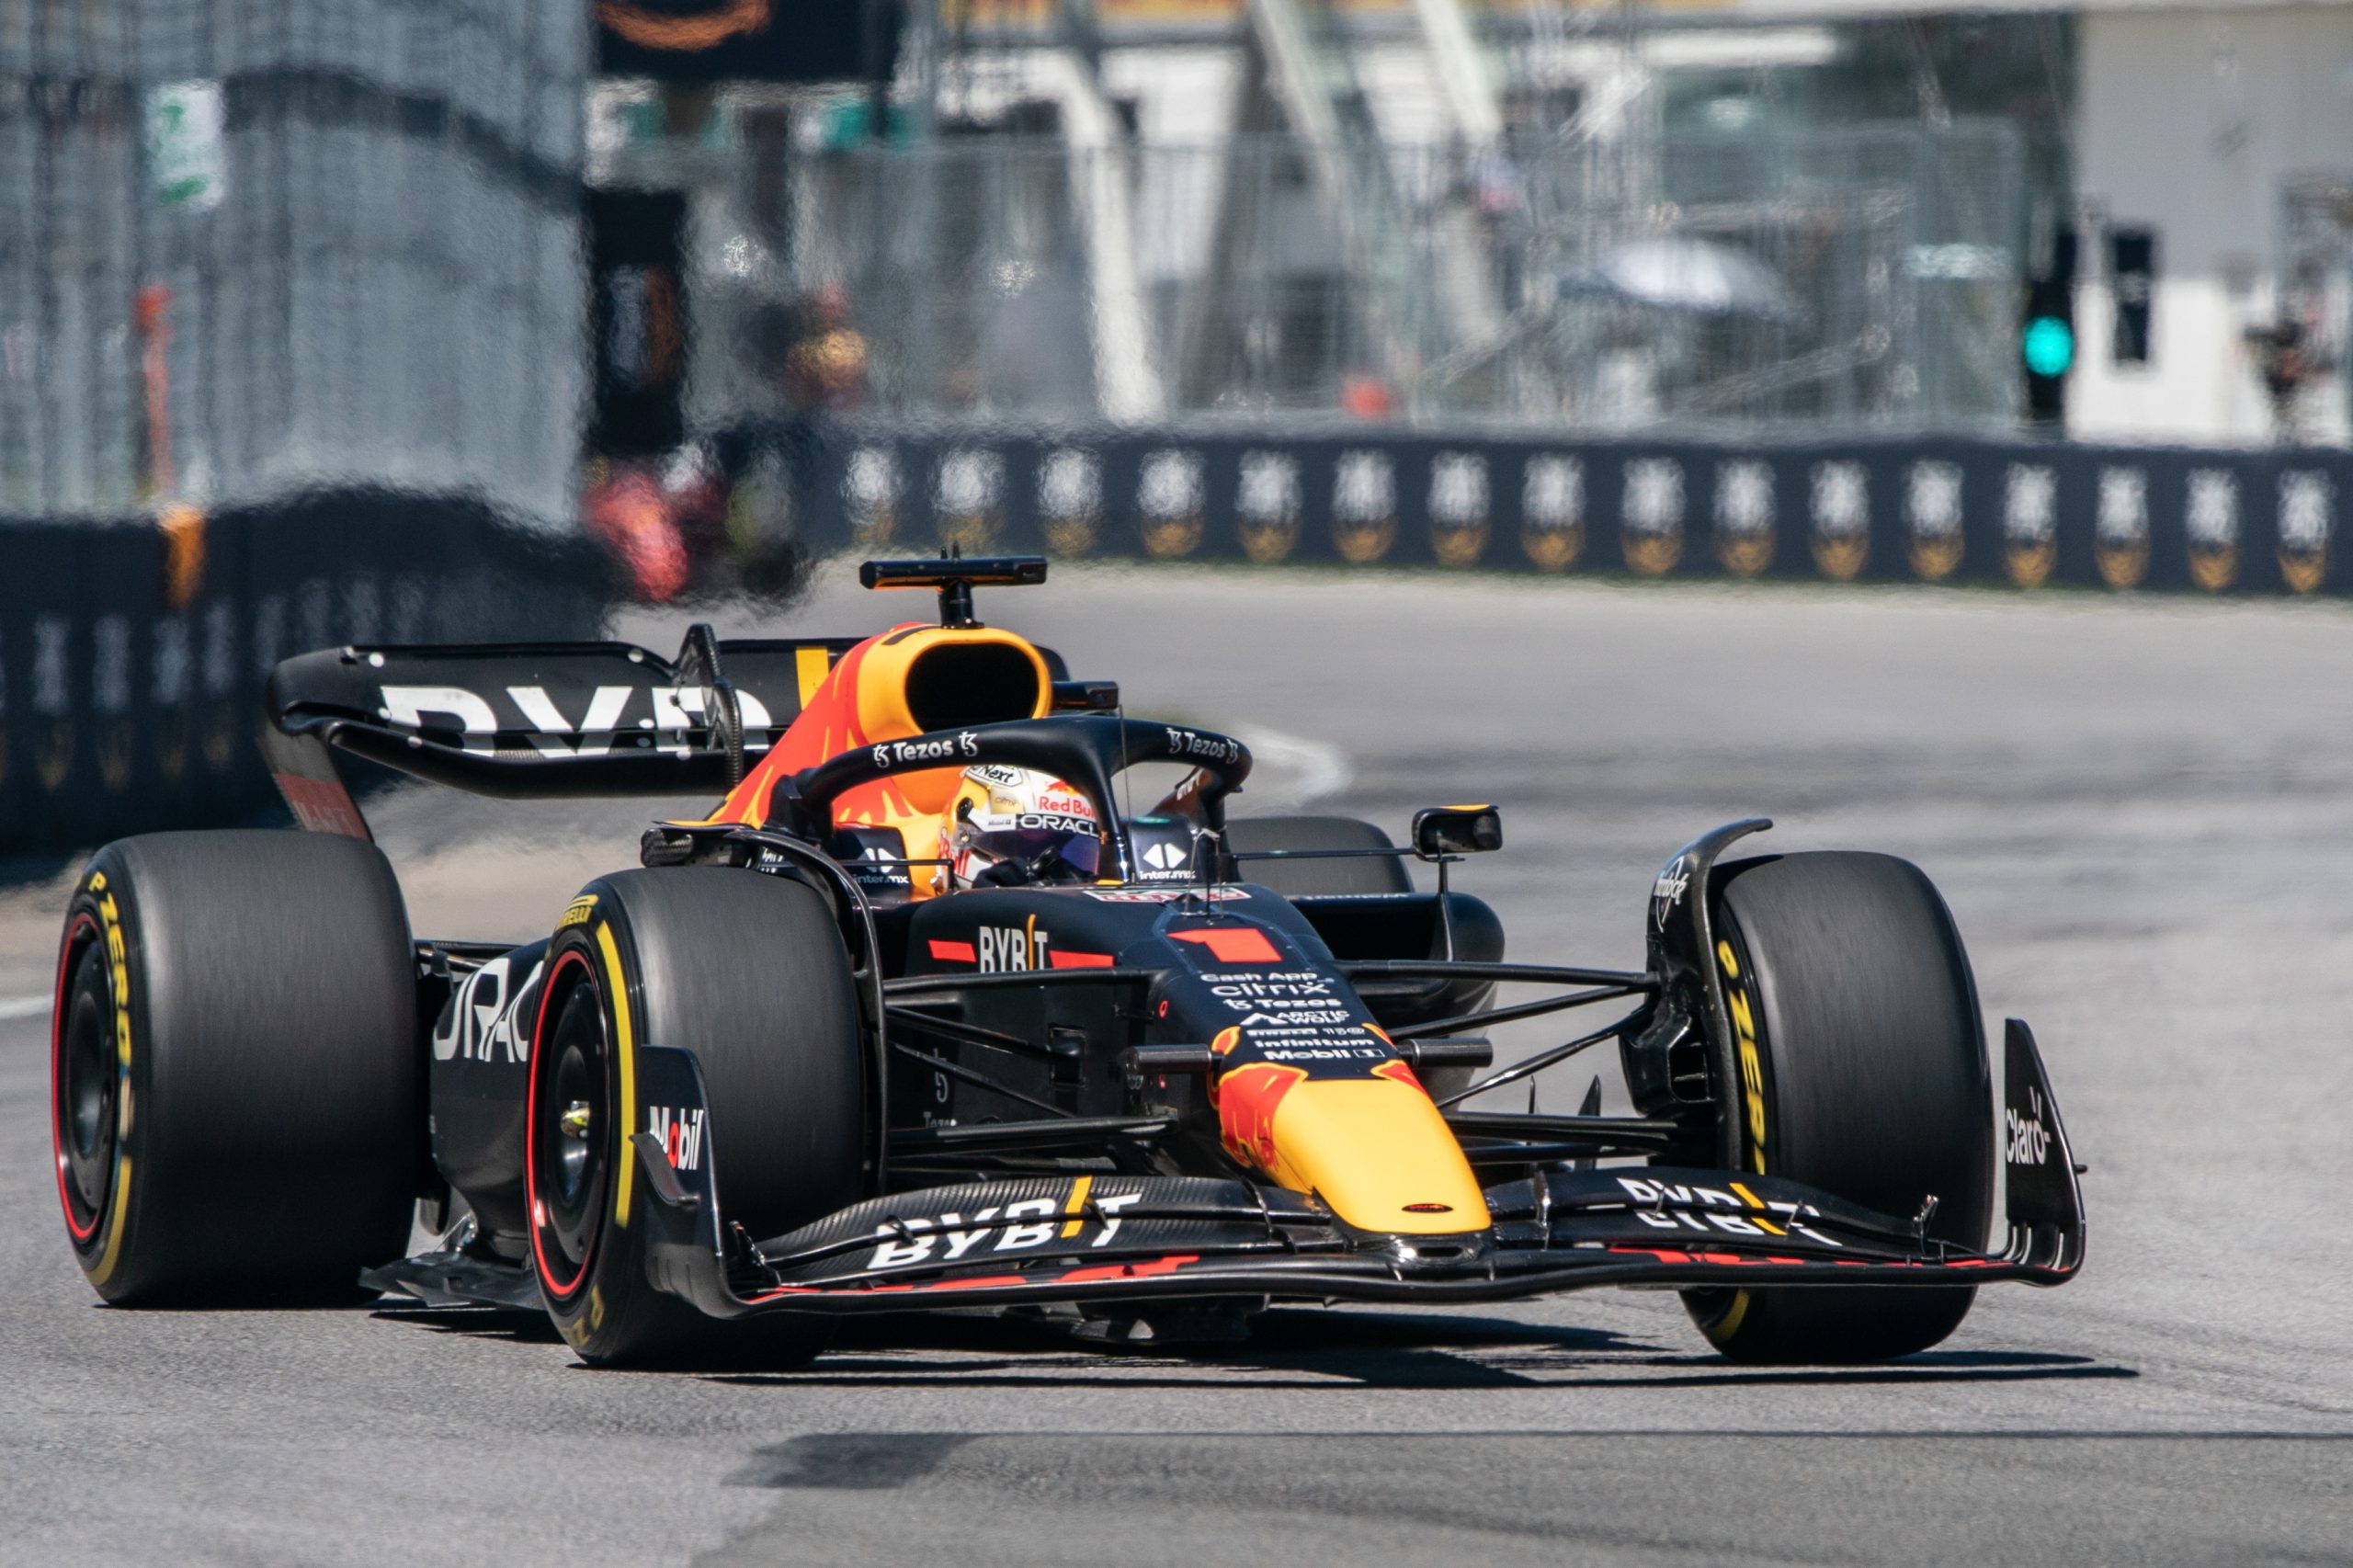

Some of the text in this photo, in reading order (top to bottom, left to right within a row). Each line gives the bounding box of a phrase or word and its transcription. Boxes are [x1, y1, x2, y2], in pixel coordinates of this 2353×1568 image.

[893, 741, 954, 762] Tezos
[1184, 732, 1226, 758] Tezos
[1039, 796, 1070, 812] Red
[979, 914, 1048, 974] BYBIT
[1255, 999, 1342, 1008] Tezos
[1263, 1050, 1351, 1060] Mobil
[649, 1106, 704, 1170] Mobil
[2006, 1108, 2047, 1165] Claro
[867, 1176, 1142, 1270] BYBIT
